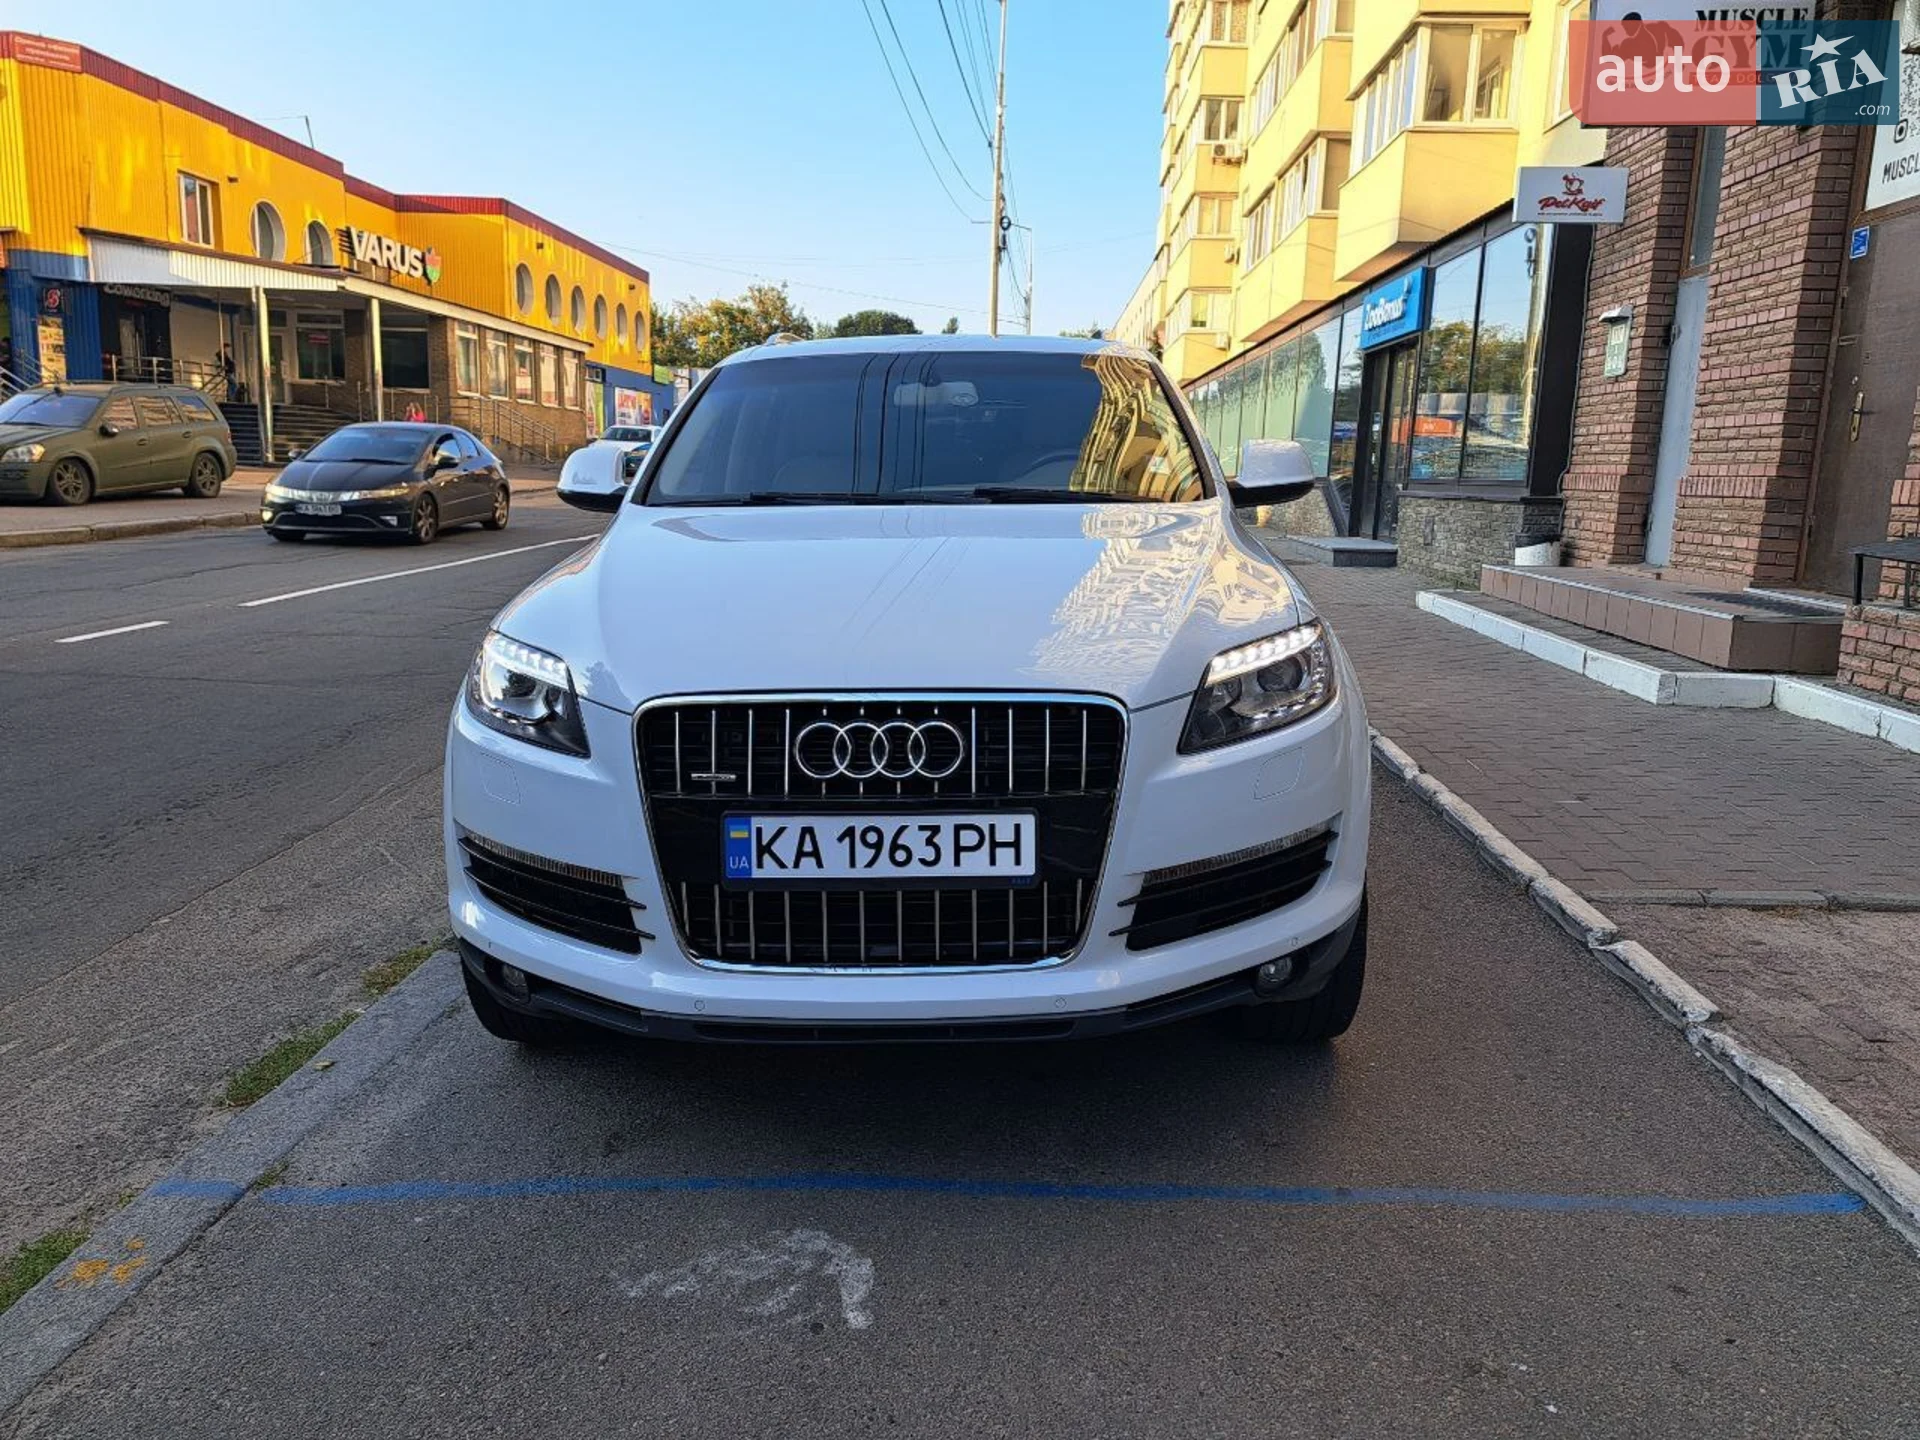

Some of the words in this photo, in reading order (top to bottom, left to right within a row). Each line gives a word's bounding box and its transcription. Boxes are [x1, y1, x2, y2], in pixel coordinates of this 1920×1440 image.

[1694, 8, 1809, 32] MUSCLE
[1691, 33, 1807, 70] GYM
[349, 225, 425, 279] VARUS
[729, 855, 749, 870] UA
[755, 825, 824, 869] KA
[836, 824, 942, 869] 1963
[953, 822, 1021, 867] PH
